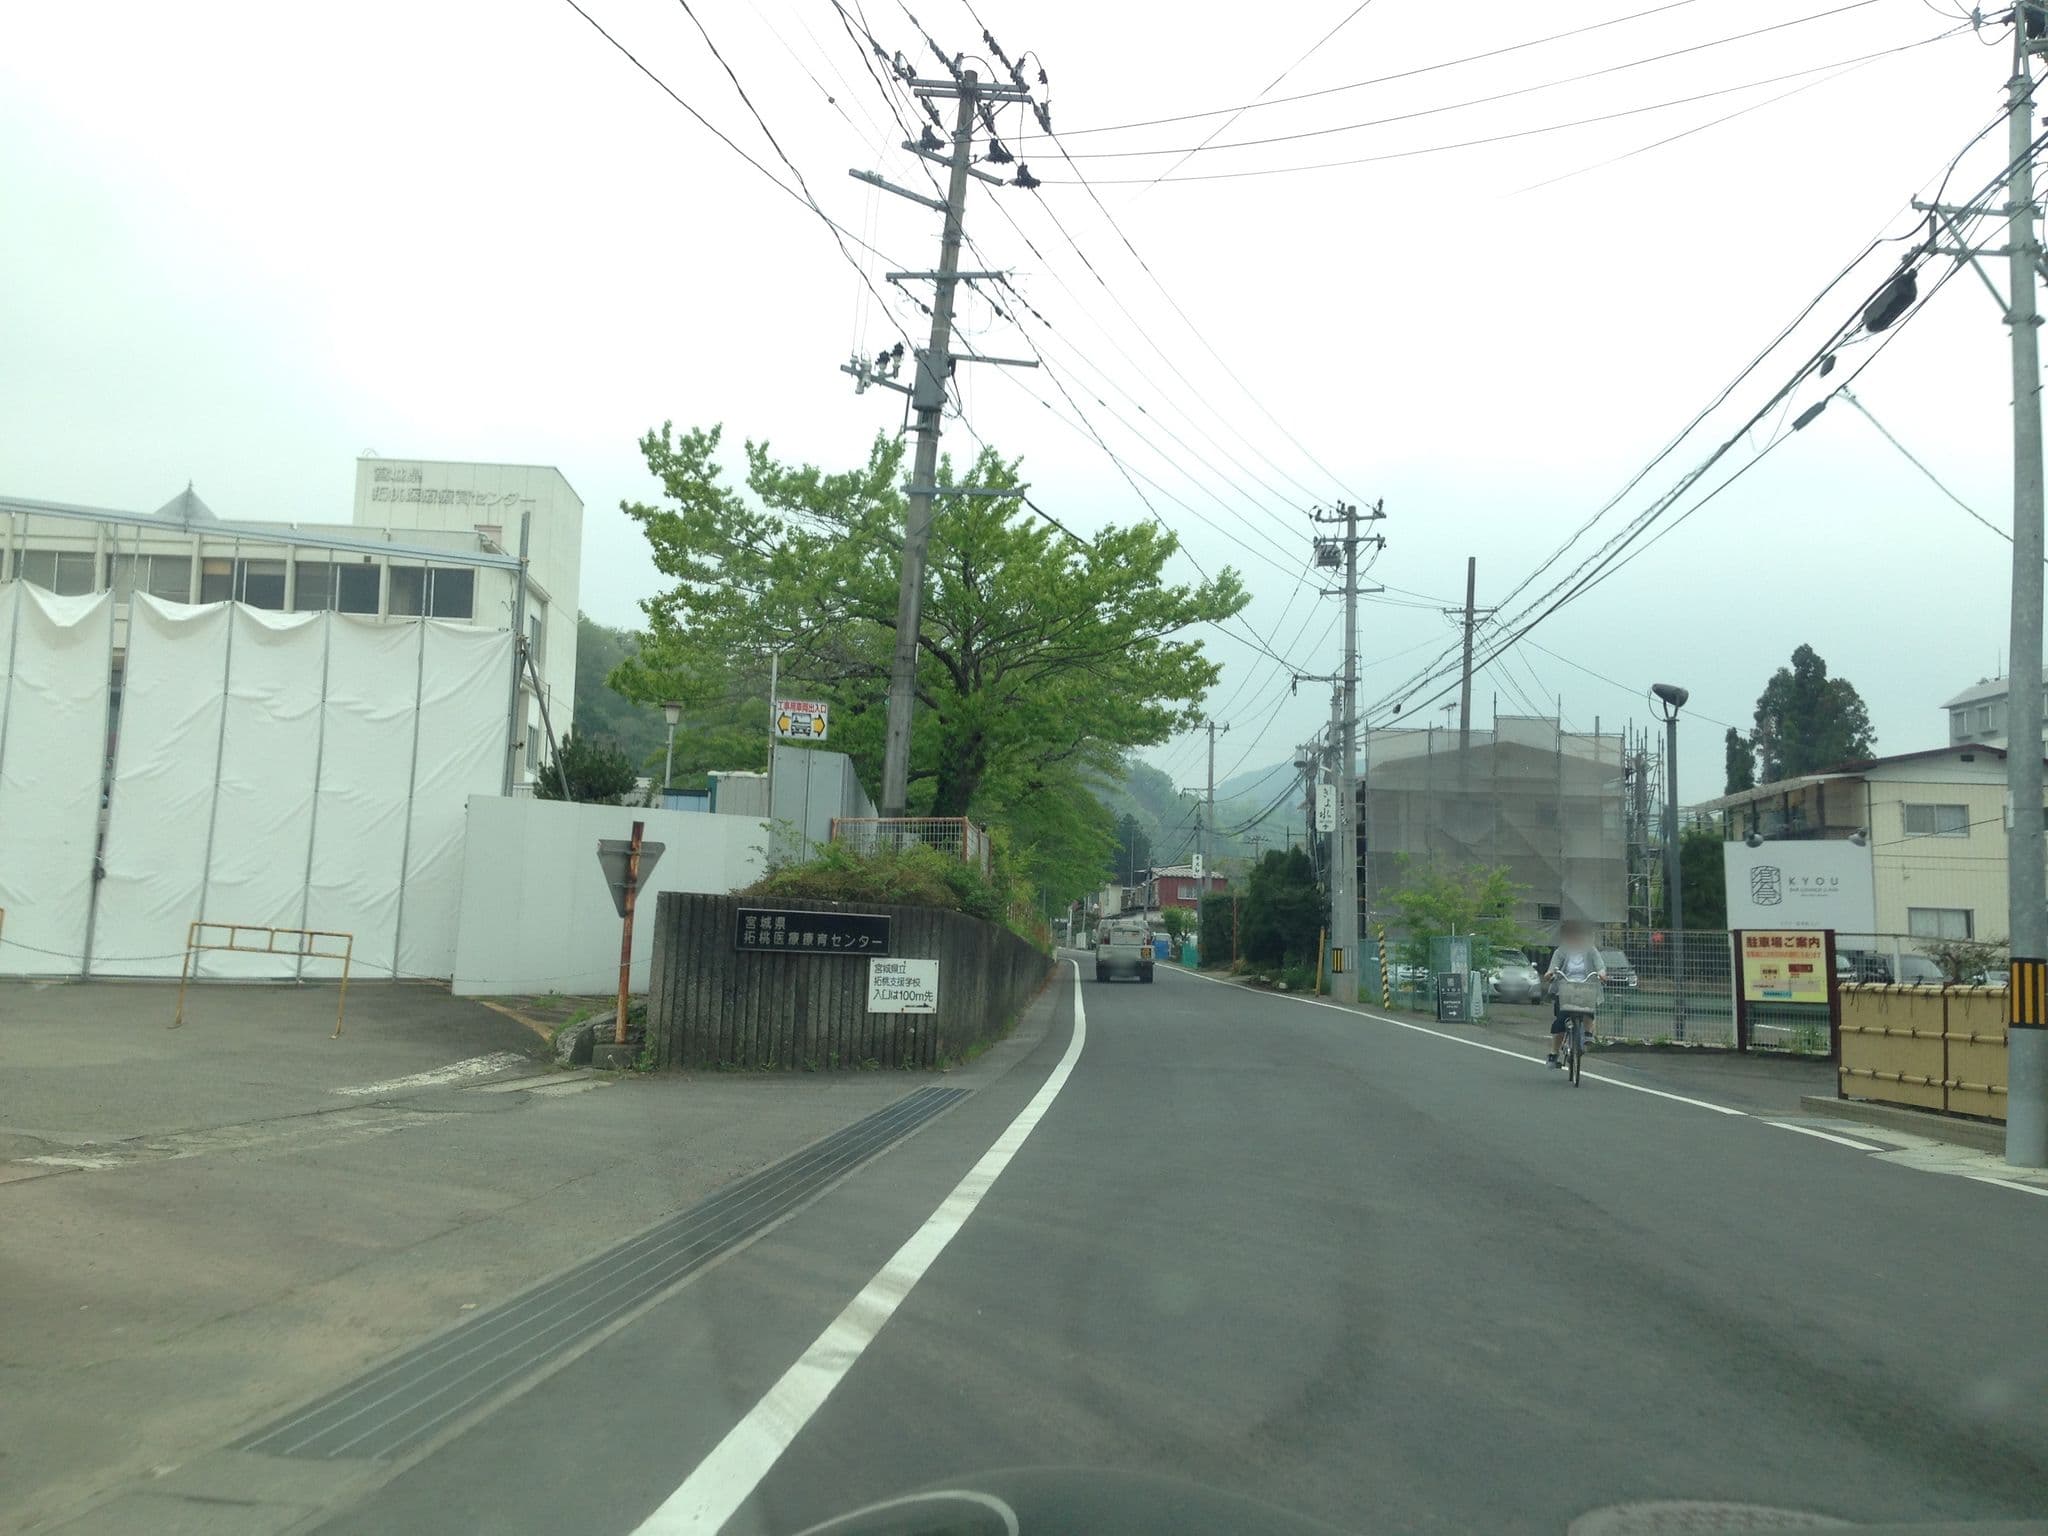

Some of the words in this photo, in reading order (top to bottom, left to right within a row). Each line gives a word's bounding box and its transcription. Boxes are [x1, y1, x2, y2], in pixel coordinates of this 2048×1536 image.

[1789, 877, 1839, 887] KYOU
[744, 916, 786, 930] 宮城県
[743, 930, 883, 948] 拓桃医療療育センター
[1746, 936, 1821, 949] 駐車場ご案内
[873, 963, 907, 975] 宮城県立
[873, 977, 921, 988] 拓桃支援学校
[872, 989, 934, 1002] 入口は100m先
